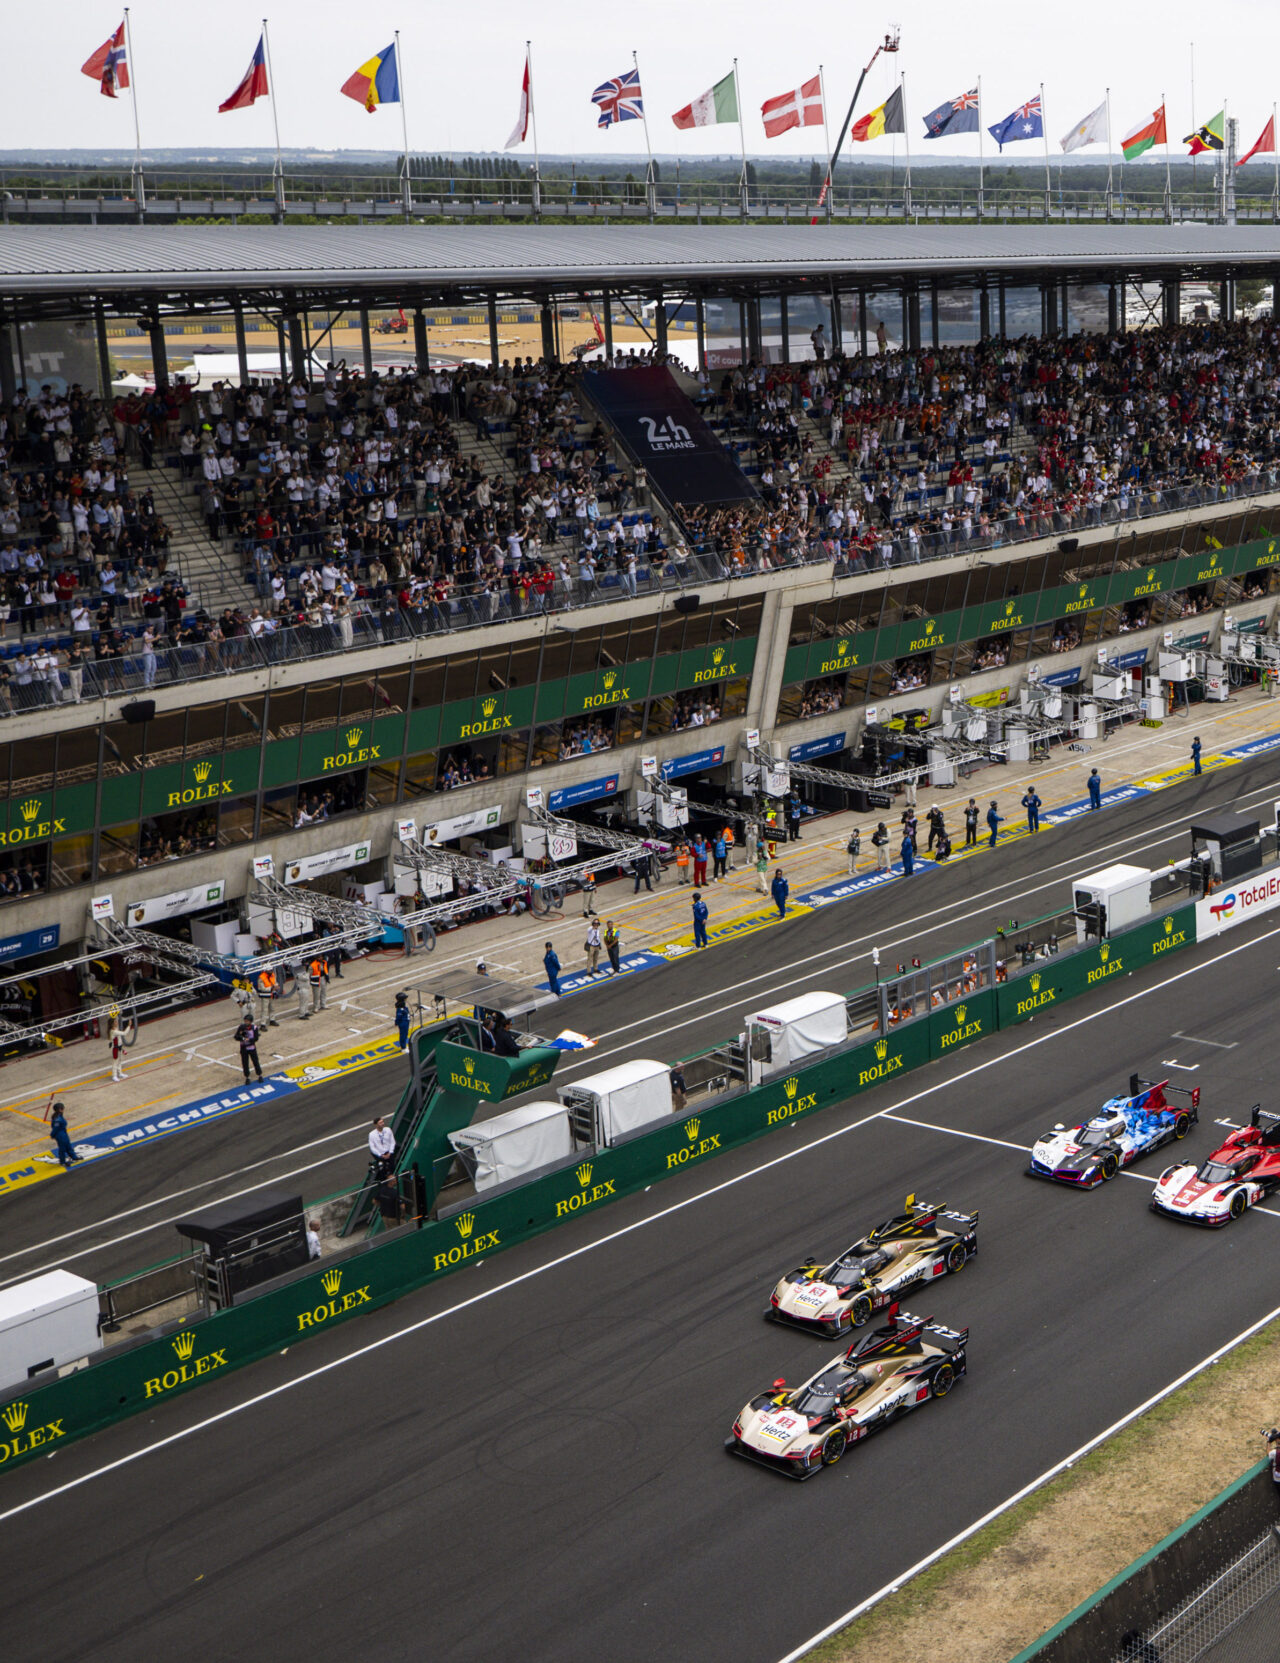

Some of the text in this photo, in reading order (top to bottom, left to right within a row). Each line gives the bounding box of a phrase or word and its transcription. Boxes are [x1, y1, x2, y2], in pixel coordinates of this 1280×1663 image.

[638, 415, 691, 443] 24h
[663, 441, 696, 450] MANS
[1257, 554, 1280, 566] ROLEX
[1198, 567, 1223, 581] ROLEX
[1134, 582, 1162, 596] ROLEX
[1065, 598, 1094, 613] ROLEX
[991, 616, 1023, 631] ROLEX
[910, 634, 945, 651] ROLEX
[694, 663, 737, 682] ROLEX
[821, 655, 859, 672] ROLEX
[584, 688, 631, 708] ROLEX
[460, 715, 512, 737] ROLEX
[323, 745, 381, 769] ROLEX
[168, 780, 233, 806] ROLEX
[357, 849, 366, 857] 92
[208, 890, 219, 899] 90
[43, 935, 53, 944] 29
[1153, 931, 1186, 954] ROLEX
[1088, 958, 1123, 983] ROLEX
[1017, 988, 1056, 1014] ROLEX
[941, 1020, 982, 1048] ROLEX
[859, 1055, 904, 1085] ROLEX
[451, 1073, 491, 1094] ROLEX
[507, 1073, 548, 1096] ROLEX
[112, 1084, 275, 1146] MICHELIN
[768, 1093, 817, 1125] ROLEX
[667, 1134, 722, 1168] ROLEX
[556, 1179, 617, 1216] ROLEX
[434, 1230, 501, 1270] ROLEX
[900, 1266, 926, 1288] Hertz
[298, 1286, 372, 1330] ROLEX
[797, 1294, 823, 1307] Hertz
[874, 1297, 883, 1308] 38
[144, 1349, 228, 1398] ROLEX
[878, 1393, 909, 1416] Hertz
[762, 1424, 791, 1441] Hertz
[848, 1430, 858, 1442] 12
